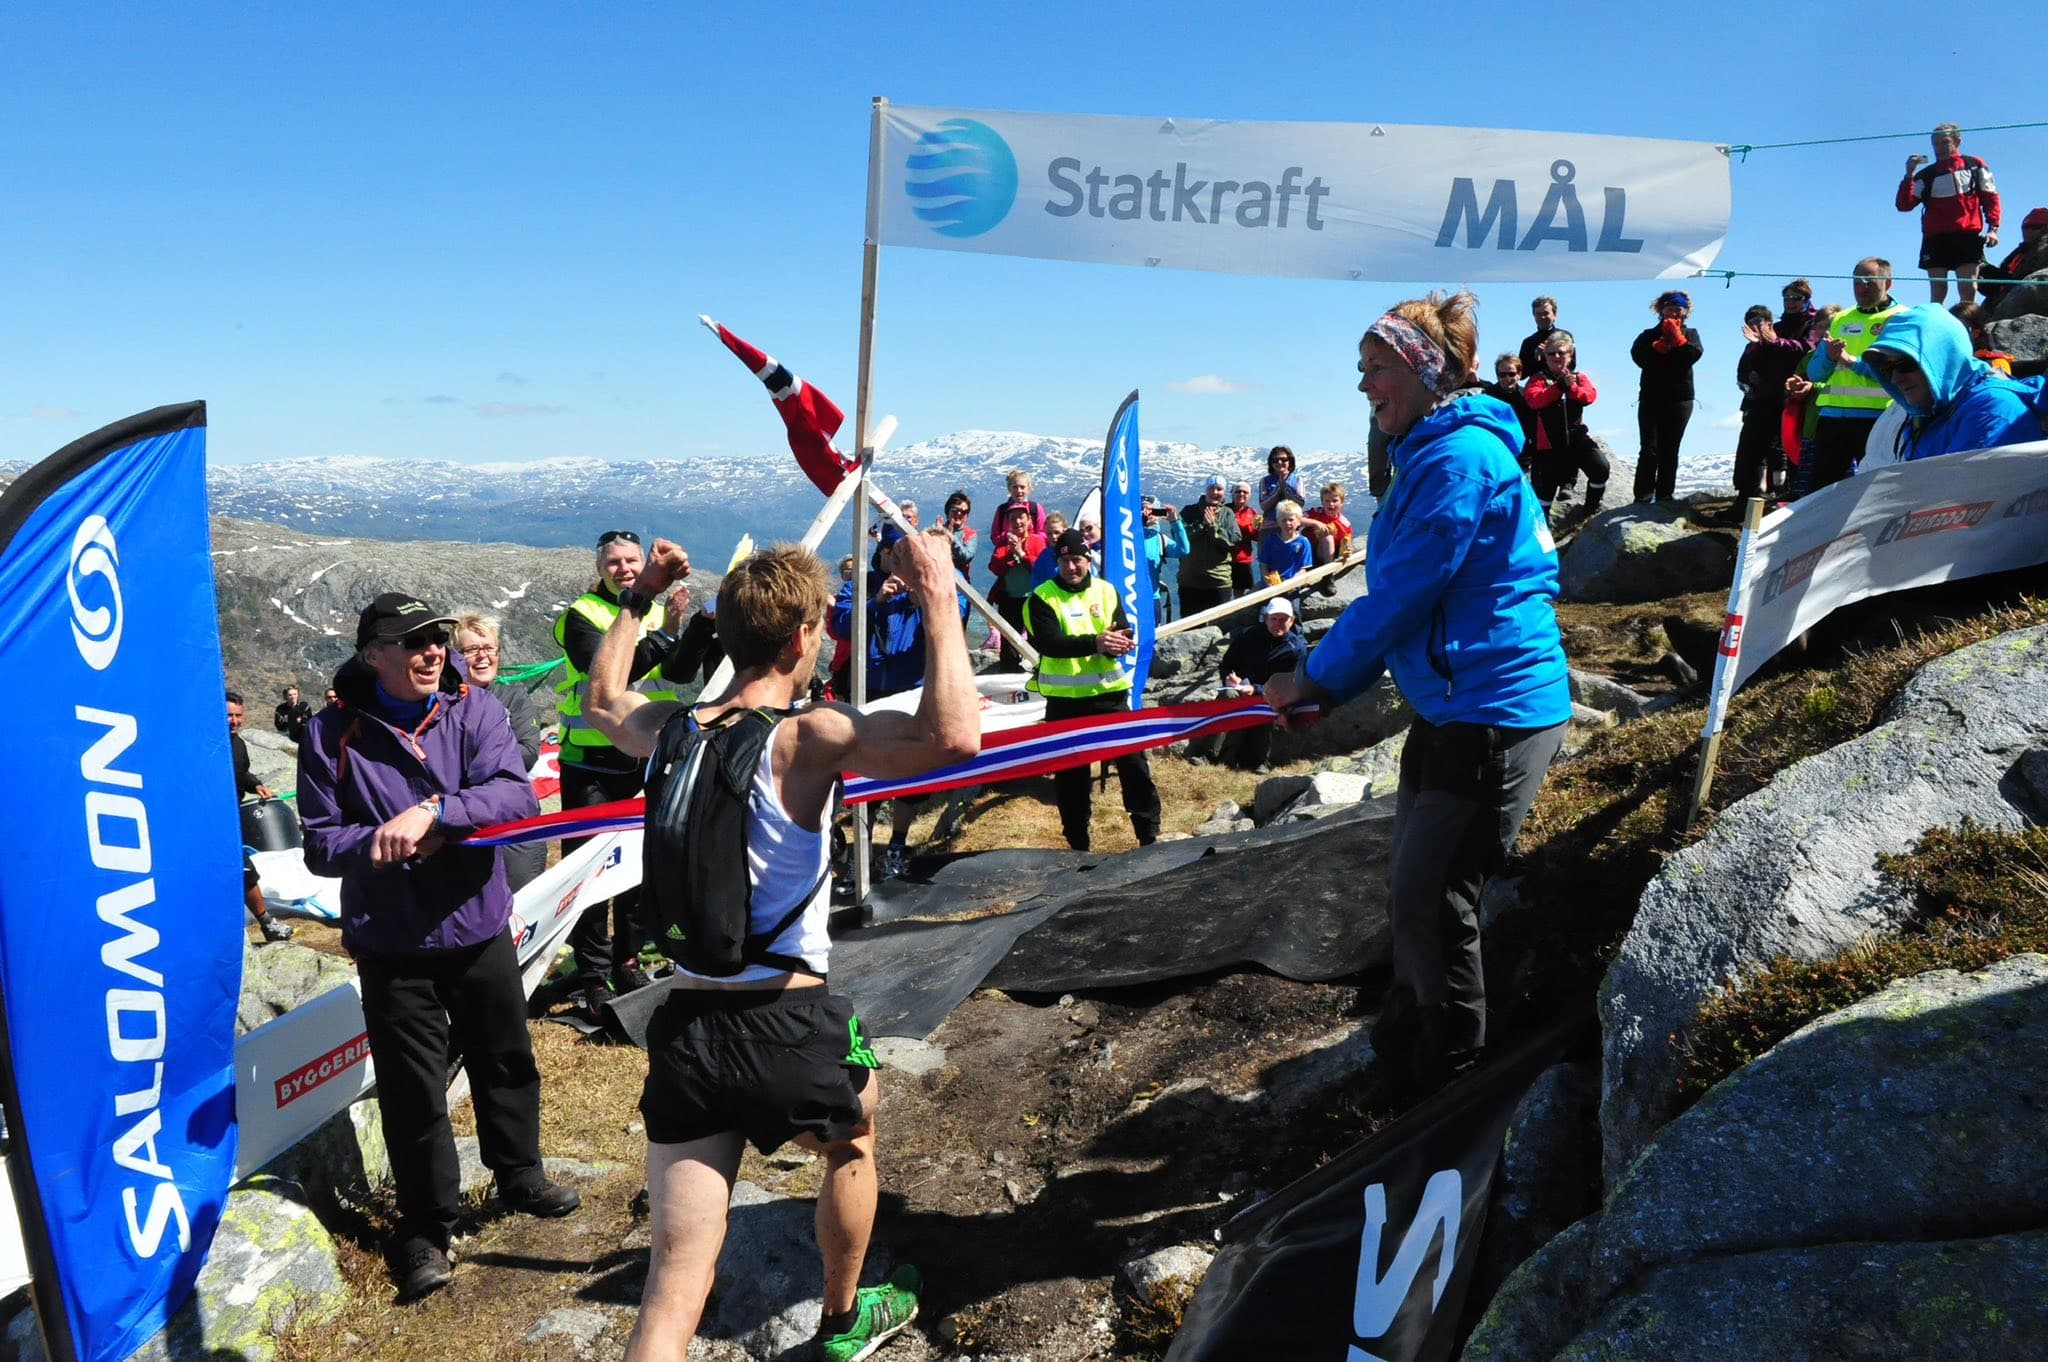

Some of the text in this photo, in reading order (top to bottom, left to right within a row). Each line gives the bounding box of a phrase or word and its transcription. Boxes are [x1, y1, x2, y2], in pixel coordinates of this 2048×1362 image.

[1043, 156, 1645, 254] Statkraft MÅL
[75, 704, 192, 1260] SALOMON
[280, 1037, 370, 1101] BYGGERIE
